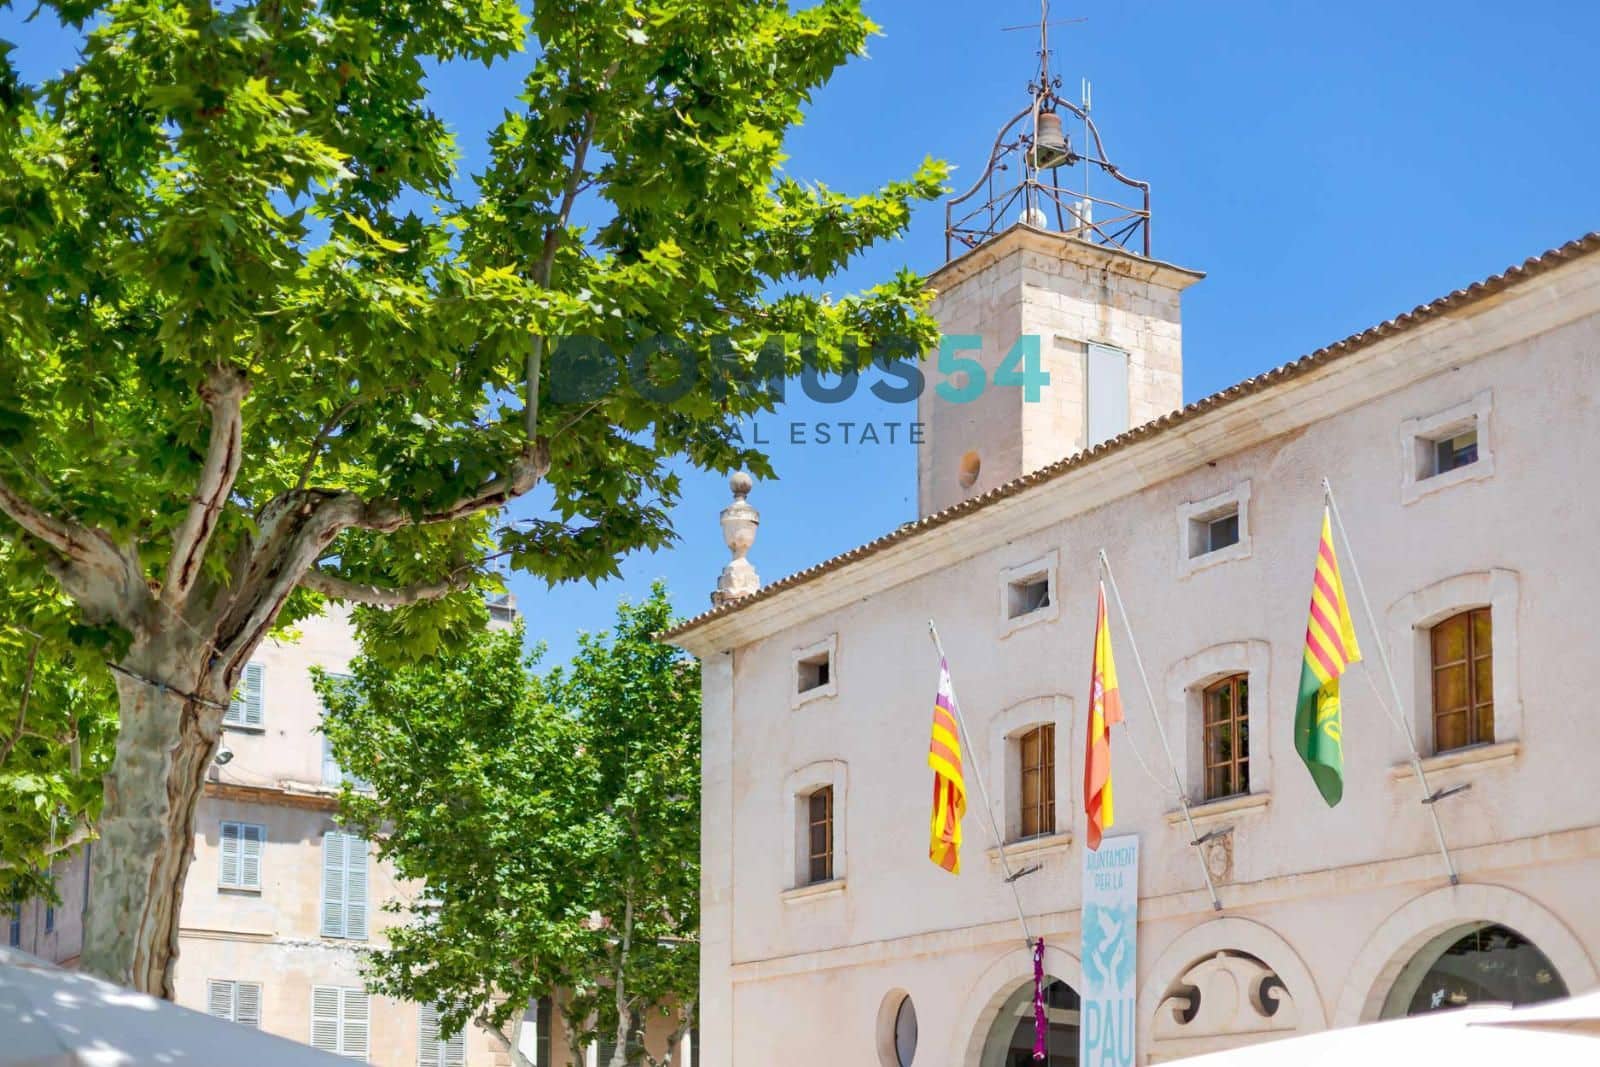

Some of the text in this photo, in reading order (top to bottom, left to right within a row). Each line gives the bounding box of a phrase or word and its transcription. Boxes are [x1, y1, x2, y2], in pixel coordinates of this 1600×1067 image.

[1095, 871, 1123, 889] PER LA
[1084, 999, 1134, 1067] PAU
